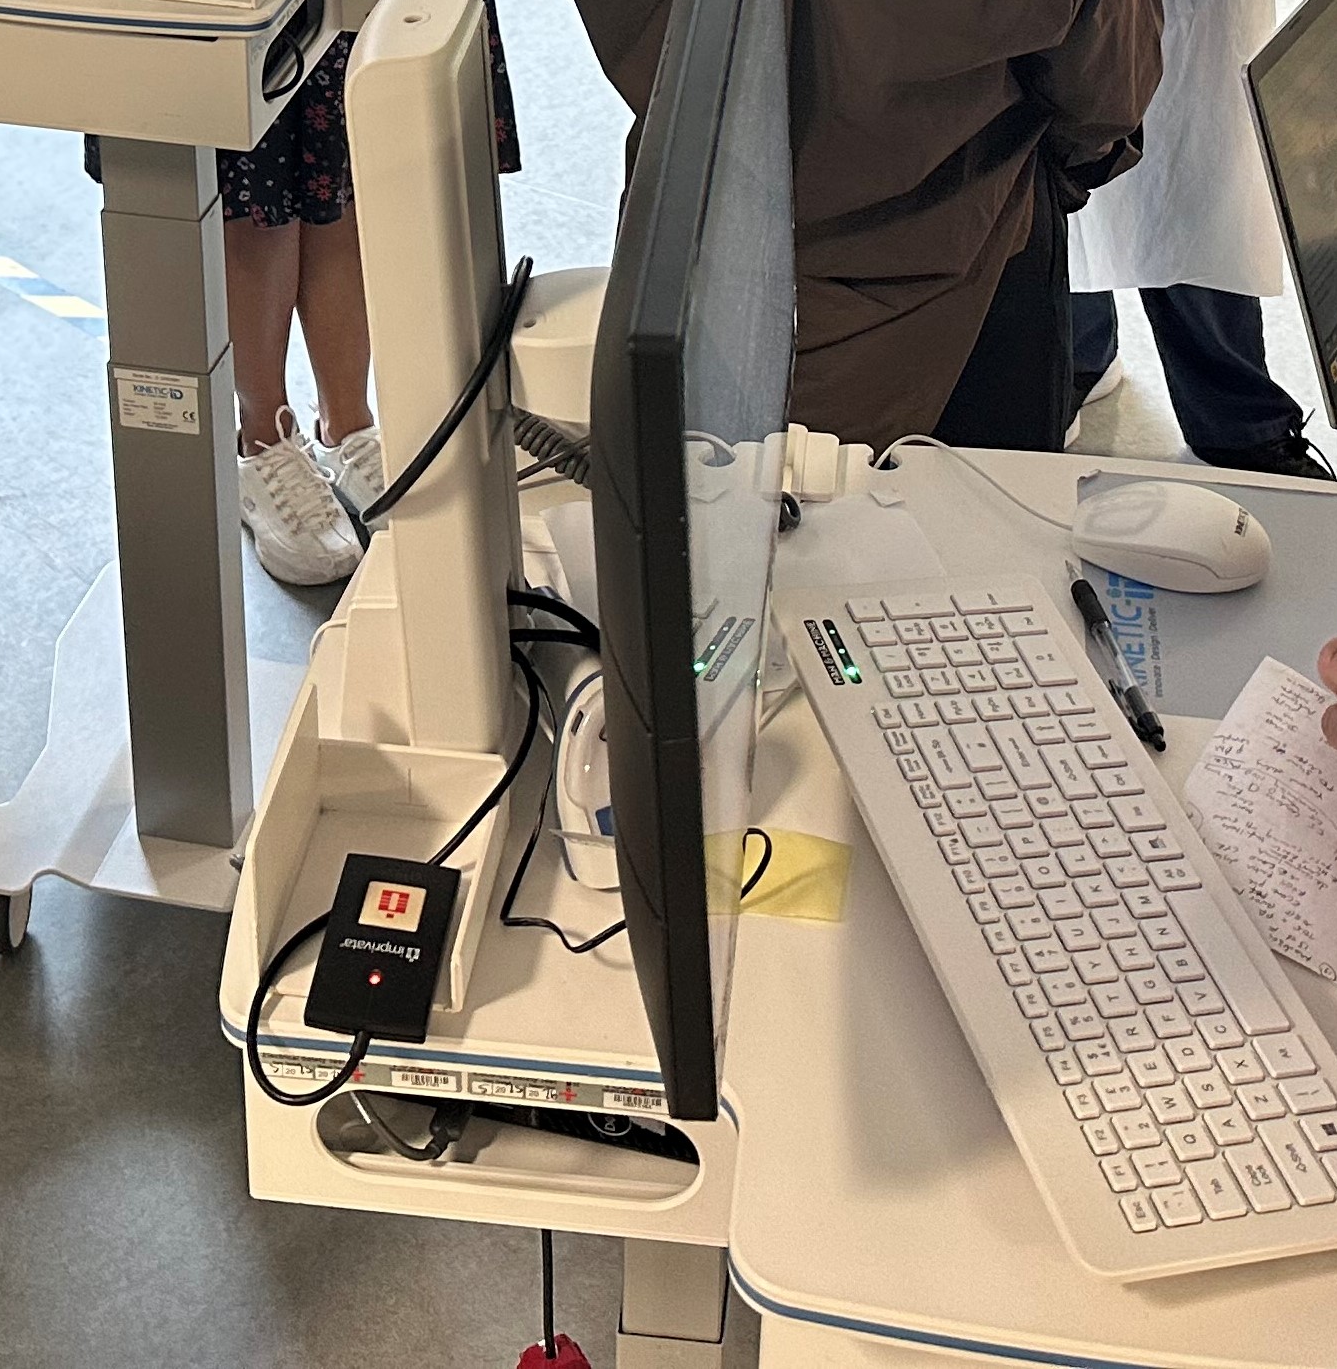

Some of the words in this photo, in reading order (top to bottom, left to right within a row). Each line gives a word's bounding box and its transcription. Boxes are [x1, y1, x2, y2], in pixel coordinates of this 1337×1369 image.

[1038, 866, 1050, 875] O
[1138, 896, 1151, 904] M
[1071, 929, 1084, 937] U
[344, 937, 404, 958] imprivata
[1125, 948, 1138, 956] H
[1176, 959, 1188, 967] B
[1144, 980, 1156, 989] G
[1195, 992, 1207, 1000] V
[1126, 1027, 1139, 1036] R
[1214, 1025, 1226, 1034] C
[1182, 1048, 1194, 1056] D
[1279, 1049, 1291, 1058] Alt
[1144, 1062, 1157, 1070] E
[1235, 1060, 1248, 1068] X
[1162, 1097, 1176, 1109] W
[1254, 1095, 1268, 1103] Z
[1222, 1119, 1235, 1127] A
[1183, 1134, 1196, 1144] Q
[1245, 1165, 1259, 1186] Caps
[1258, 1165, 1273, 1185] Lock
[1210, 1179, 1223, 1194] Tab
[1133, 1198, 1148, 1219] Esc
